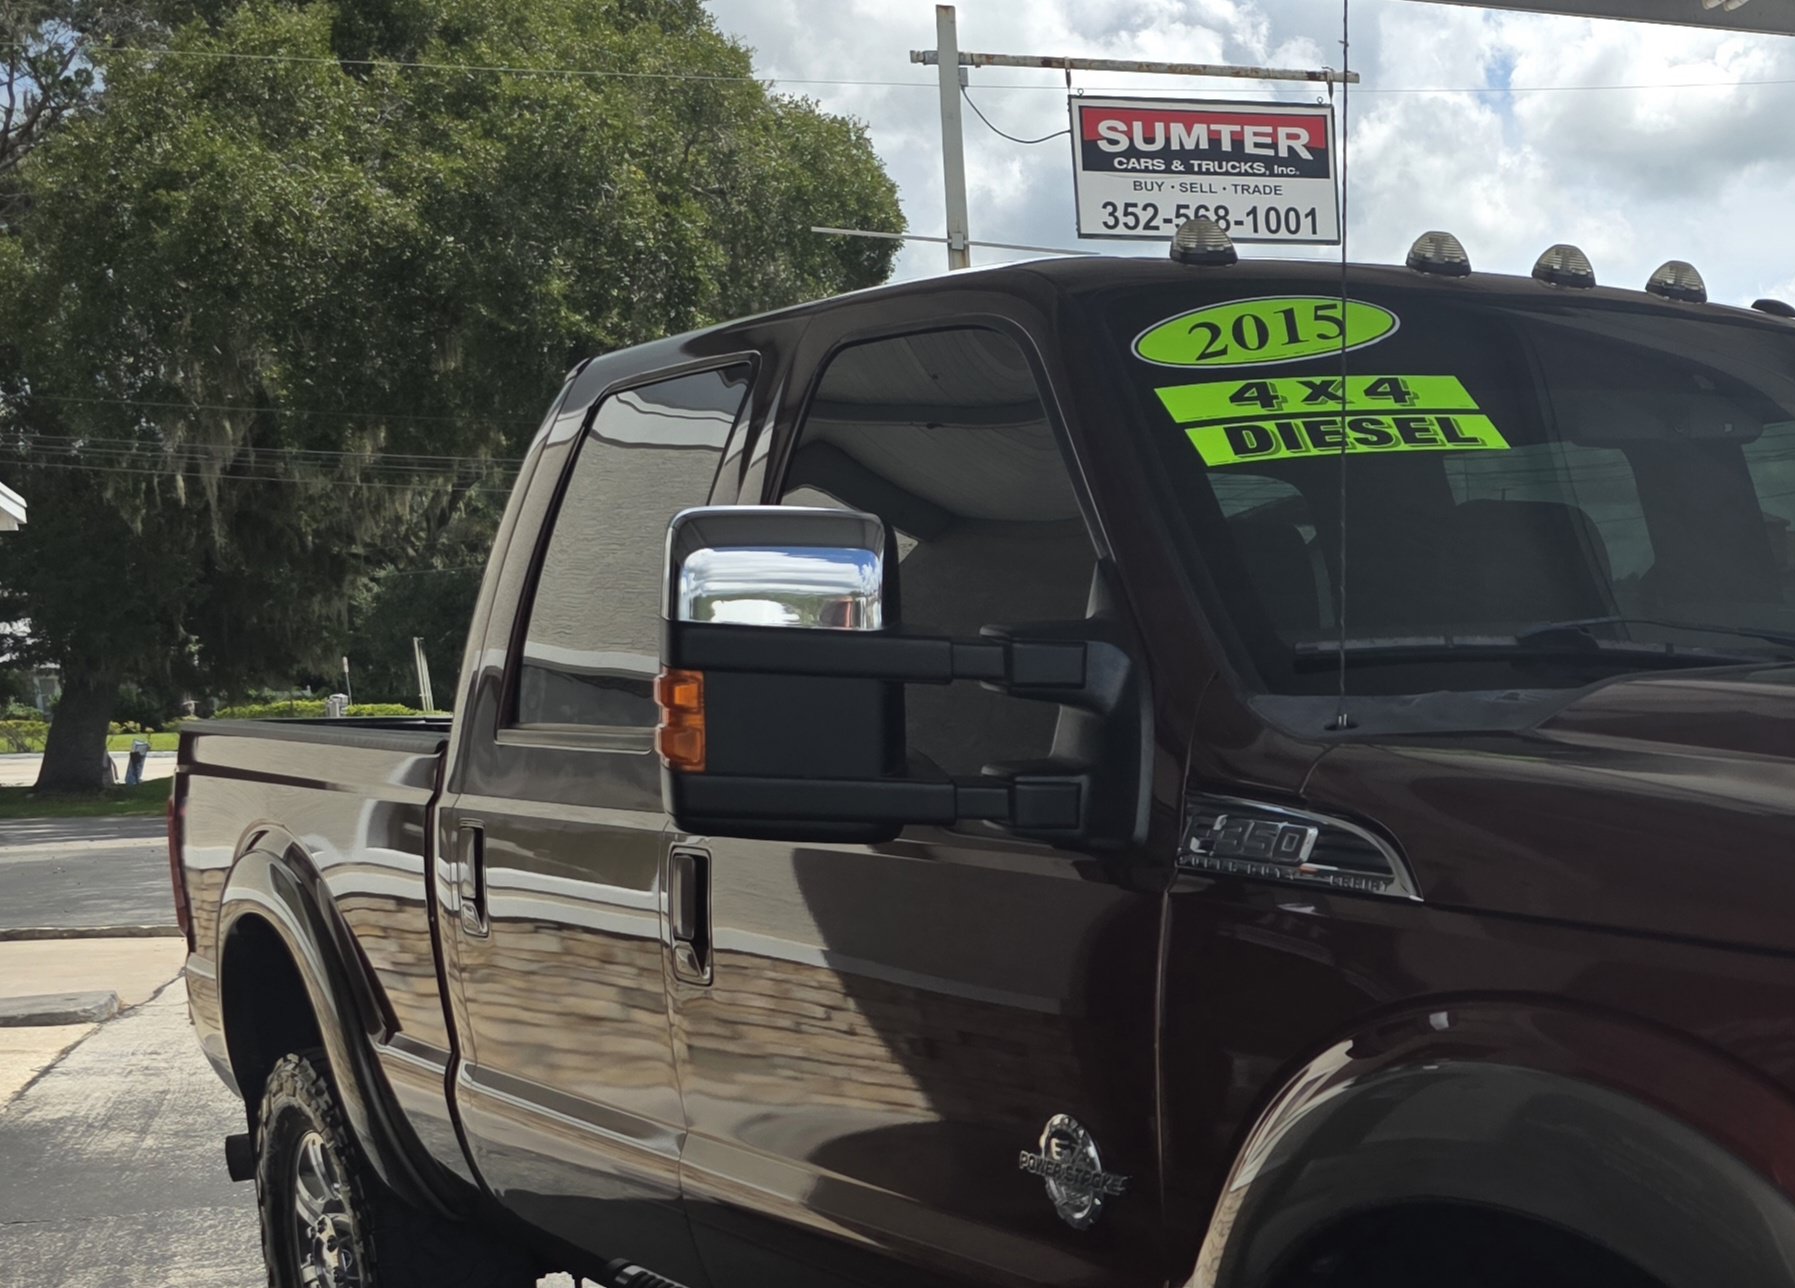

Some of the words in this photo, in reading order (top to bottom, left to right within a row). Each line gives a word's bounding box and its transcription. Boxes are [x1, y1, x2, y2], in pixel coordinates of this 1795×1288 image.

[1096, 118, 1315, 161] SUMTER
[1113, 156, 1166, 172] CARS
[1171, 159, 1186, 173] &
[1189, 159, 1270, 176] TRUCKS,
[1273, 164, 1301, 176] Inc.
[1132, 179, 1166, 193] BUY
[1178, 181, 1218, 195] SELL
[1230, 183, 1284, 196] TRADE
[1187, 302, 1345, 362] 2015
[1222, 415, 1488, 459] DIESEL
